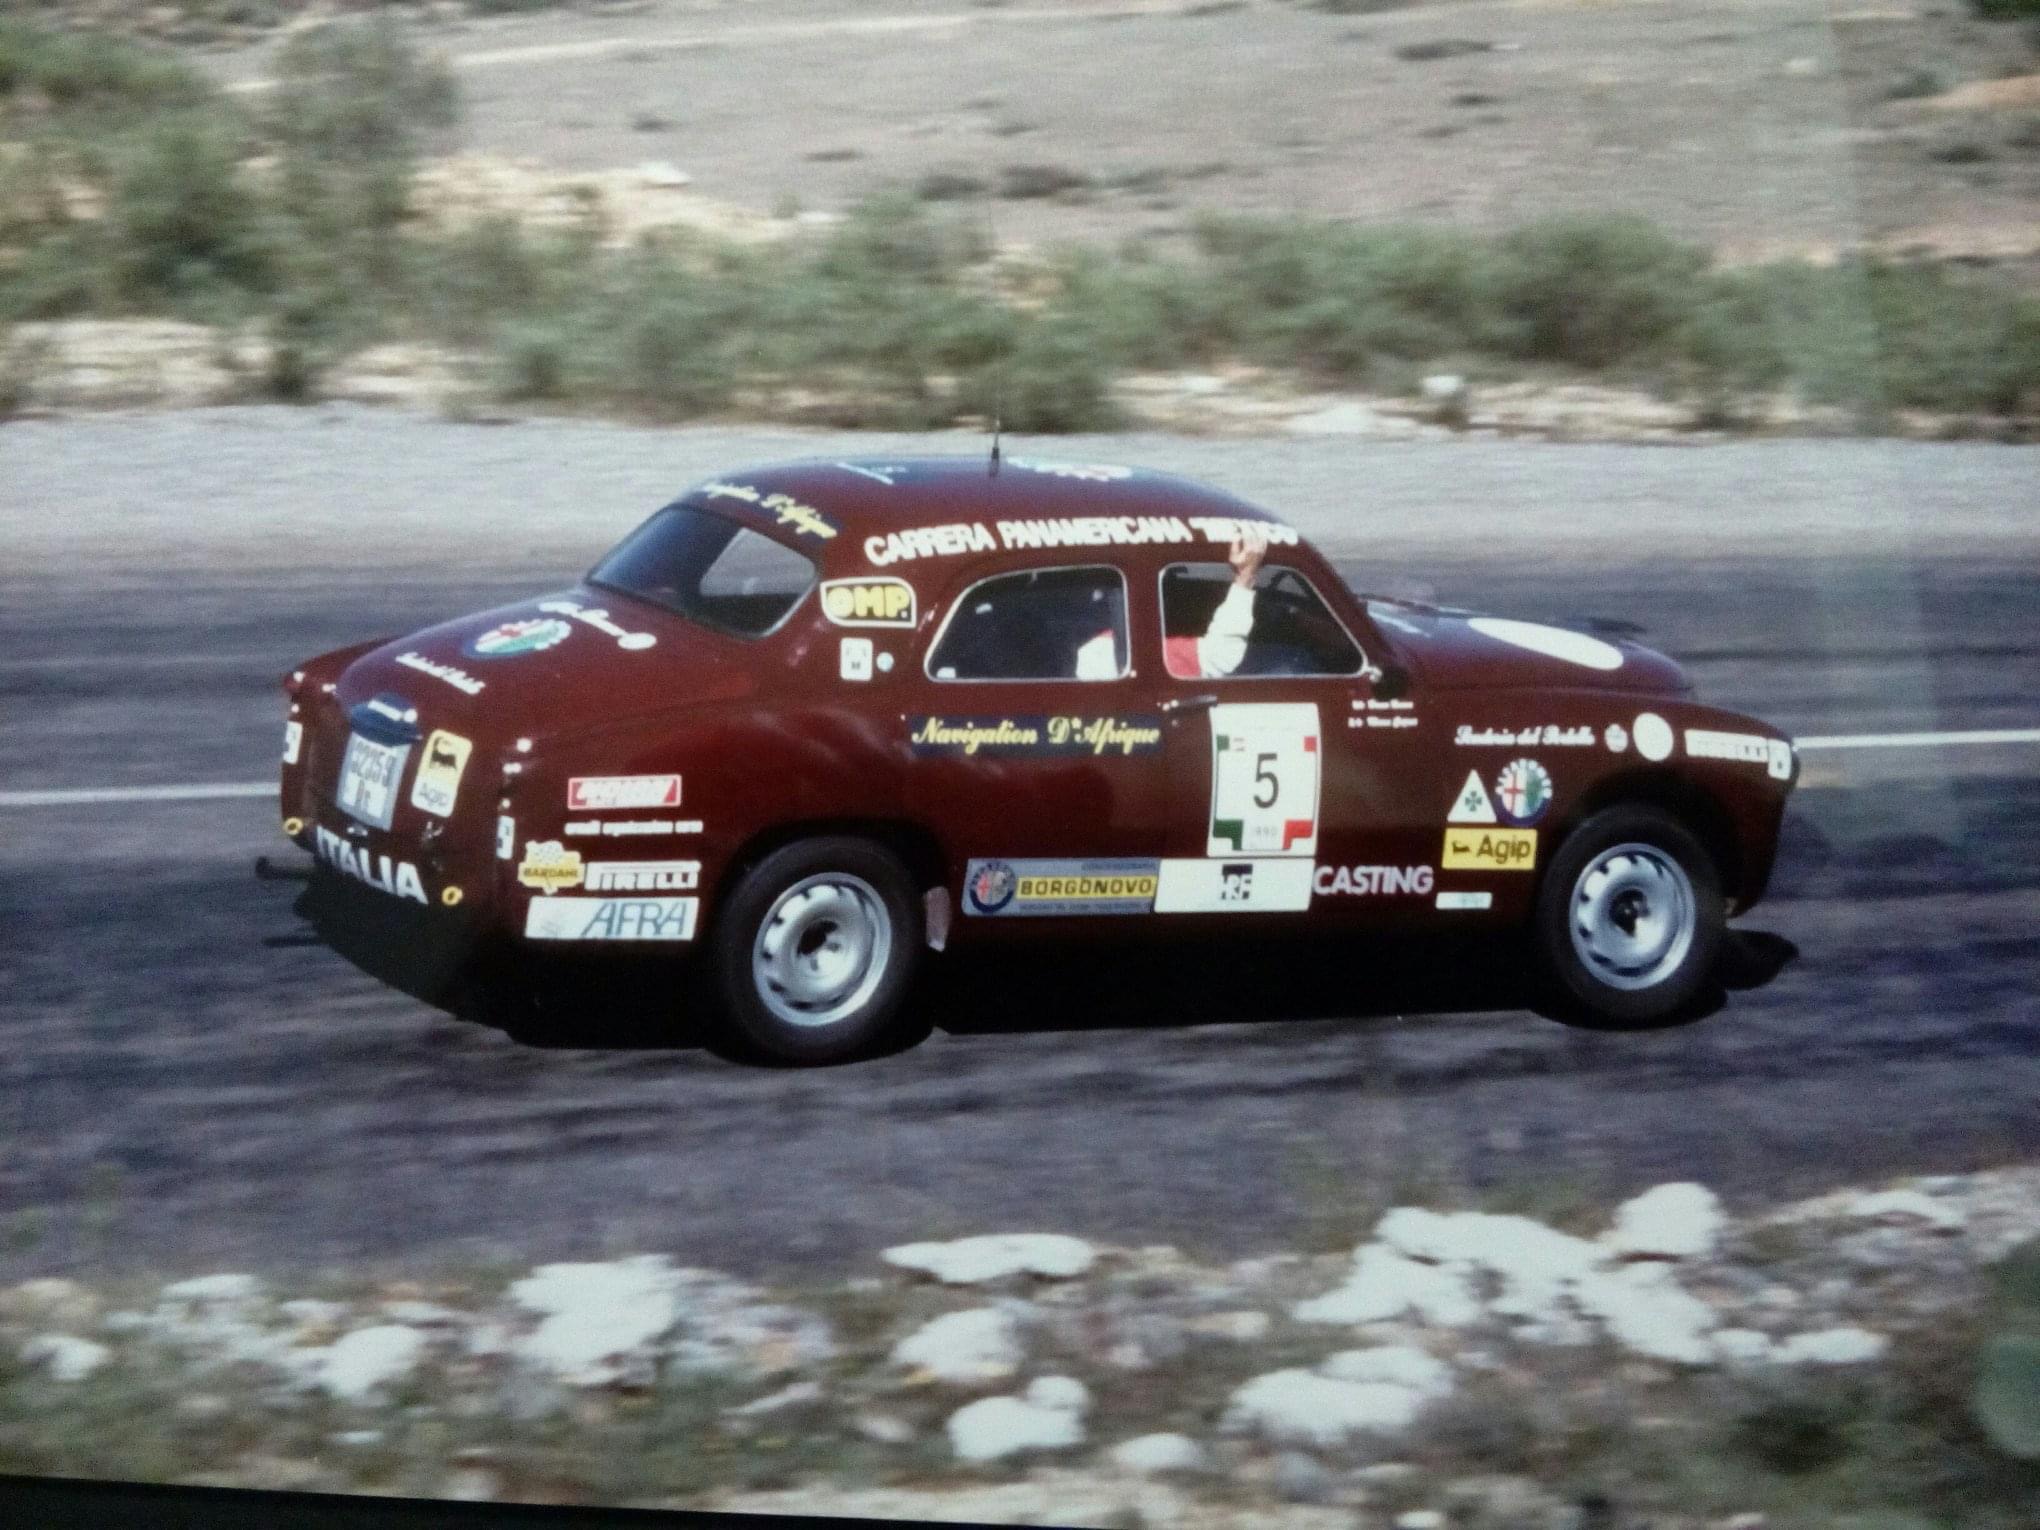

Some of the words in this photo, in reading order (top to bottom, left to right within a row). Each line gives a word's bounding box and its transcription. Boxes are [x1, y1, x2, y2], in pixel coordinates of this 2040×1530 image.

[863, 522, 997, 567] CARRERA
[996, 516, 1194, 549] PANAMERICANA
[911, 716, 1039, 755] Navigation
[1253, 752, 1279, 809] 5
[316, 825, 429, 905] ITALIA
[1477, 834, 1531, 865] Agip
[1312, 865, 1434, 894] CASTING
[580, 902, 688, 937] AFRA
